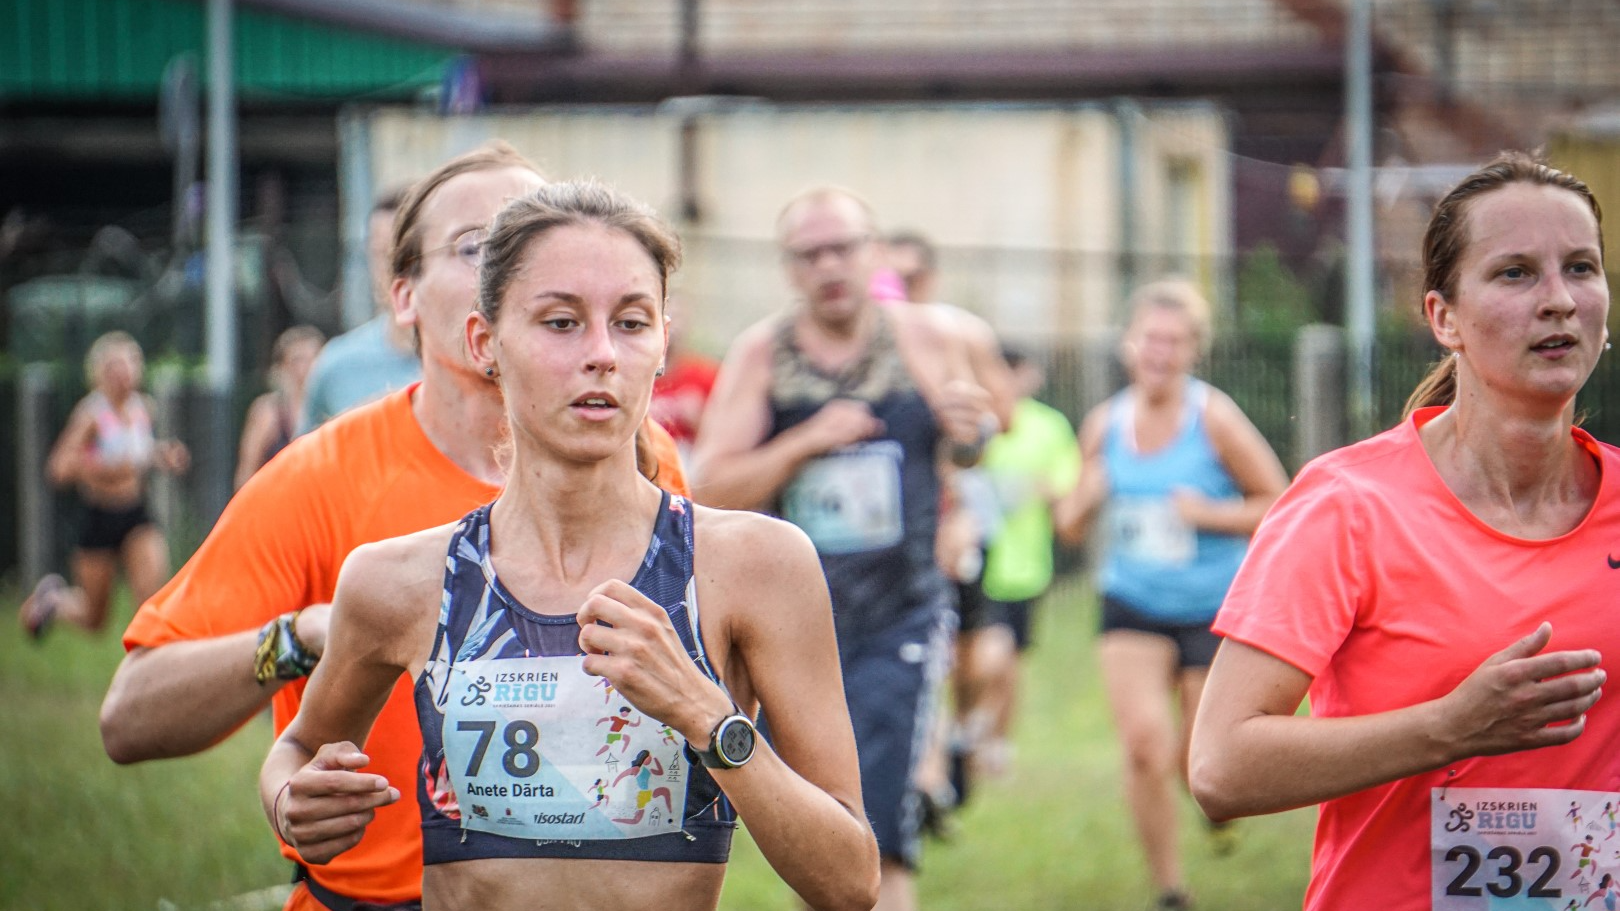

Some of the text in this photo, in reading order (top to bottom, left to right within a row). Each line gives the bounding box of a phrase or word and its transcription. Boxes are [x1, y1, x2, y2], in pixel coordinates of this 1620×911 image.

[495, 672, 559, 683] IZSKRIEN
[456, 720, 540, 778] 78
[467, 782, 554, 797] Anete Dārta
[1476, 801, 1538, 811] IZSKRIEN
[1445, 845, 1562, 898] 232
